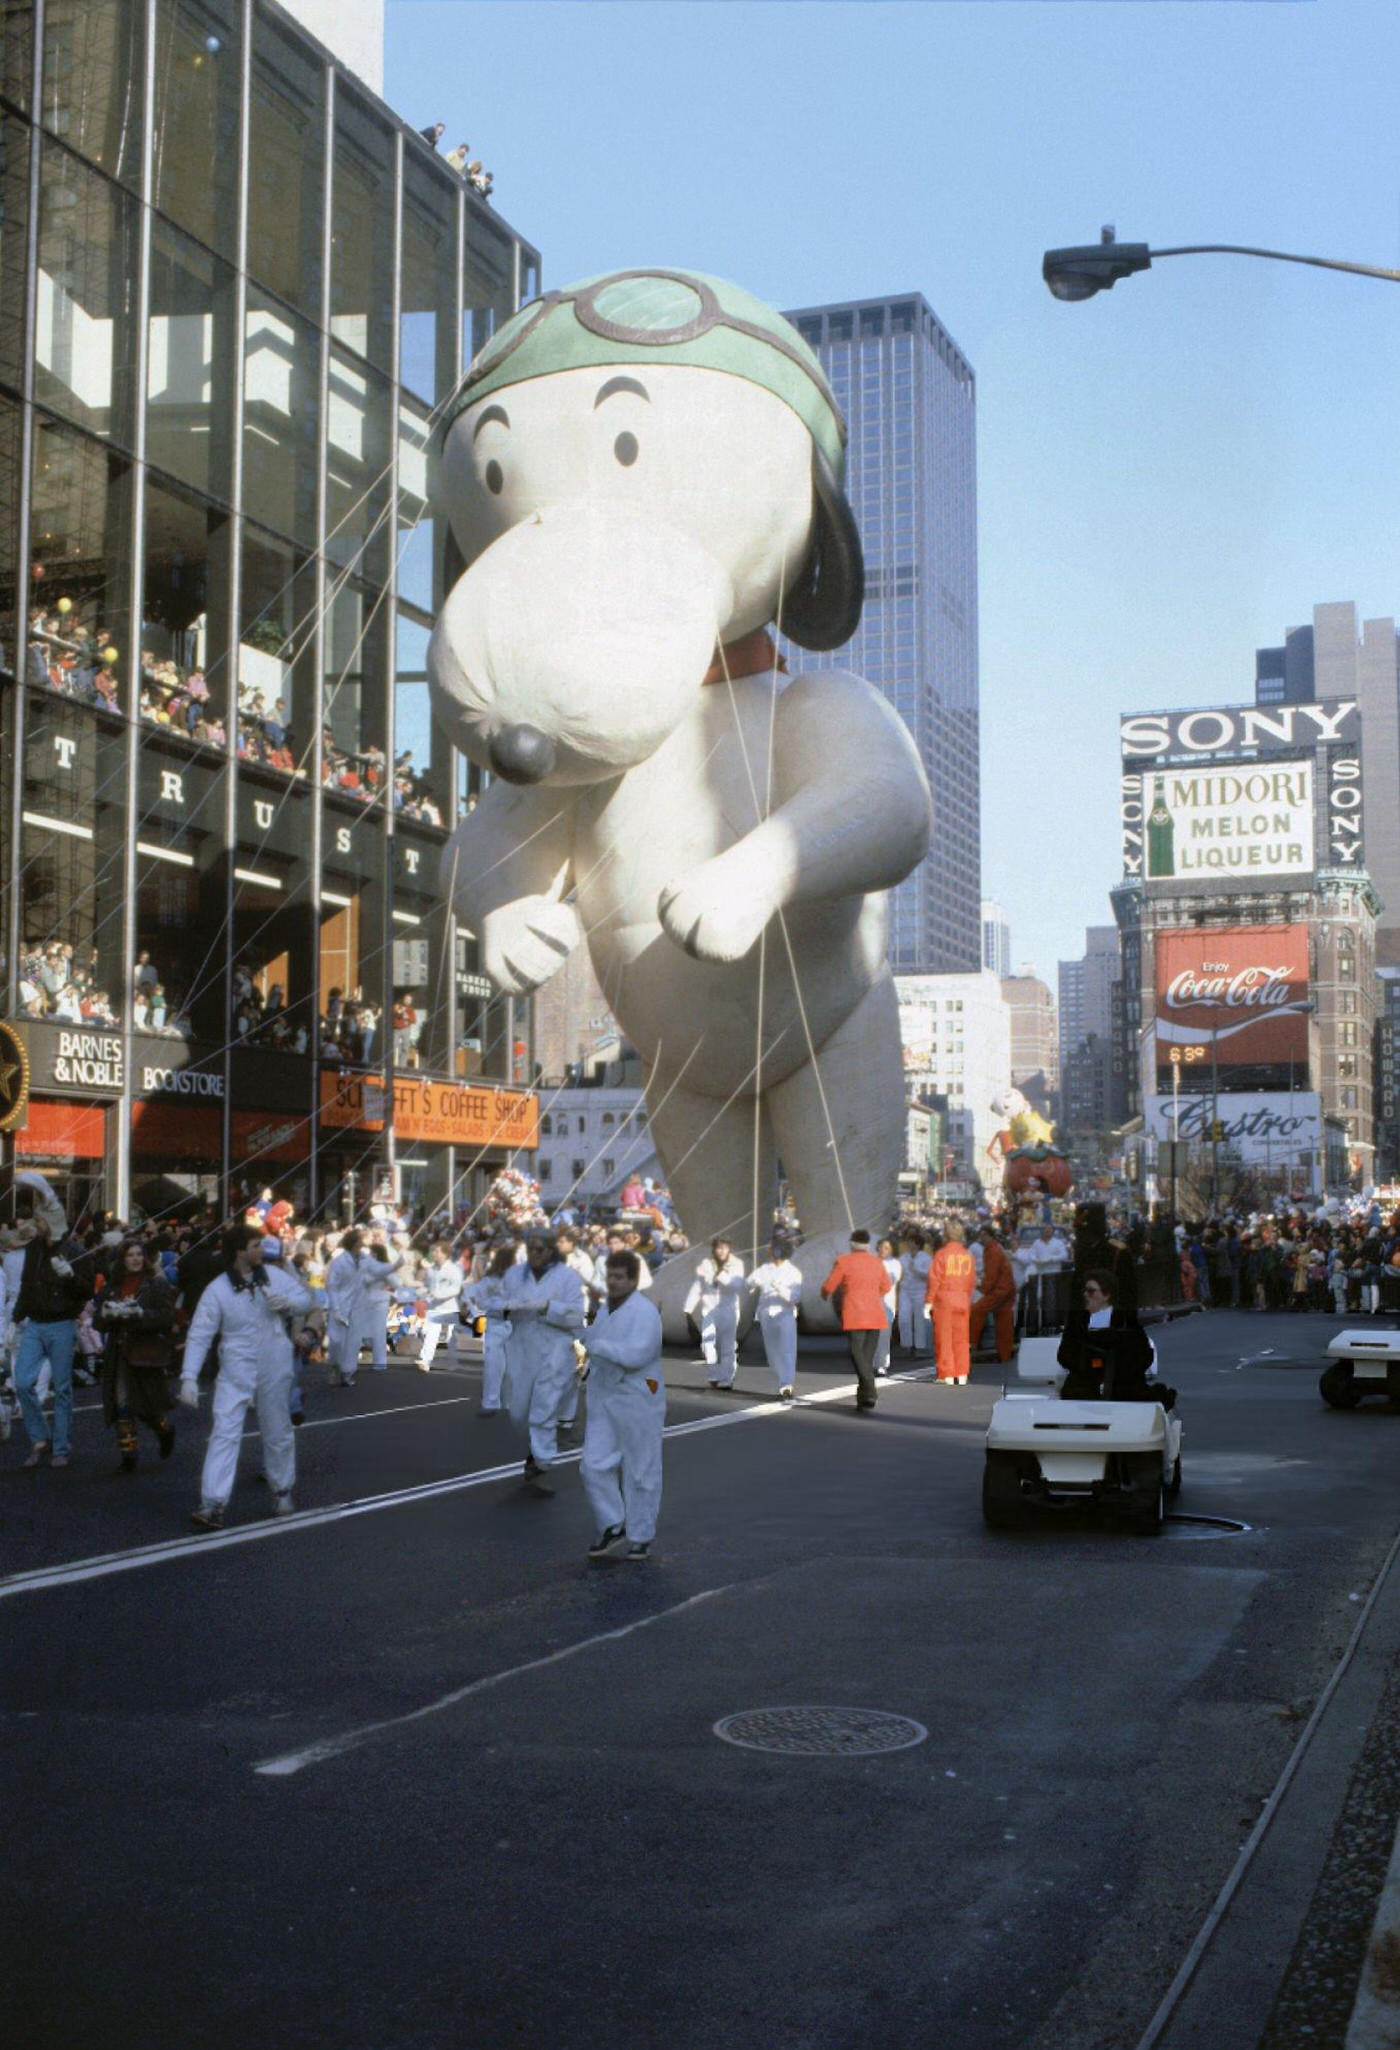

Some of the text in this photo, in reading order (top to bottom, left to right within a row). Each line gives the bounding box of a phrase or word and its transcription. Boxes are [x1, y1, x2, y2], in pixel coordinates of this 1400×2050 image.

[1120, 702, 1356, 755] SONY
[1173, 770, 1307, 808] MIDORI
[1120, 775, 1142, 874] SONY
[1191, 813, 1291, 838] MELON
[1331, 758, 1361, 862] SONY
[1181, 843, 1303, 869] LIQUEUR
[1203, 961, 1229, 973] Enjoy
[1167, 966, 1295, 1007] Coca-Cola
[59, 1032, 122, 1061] BARNES
[72, 1059, 123, 1087] NOBLE
[144, 1067, 225, 1096] BOOKSTORE
[1382, 1027, 1394, 1118] HOWARD
[440, 1091, 487, 1119] COFFEE
[495, 1097, 527, 1123] SHOP
